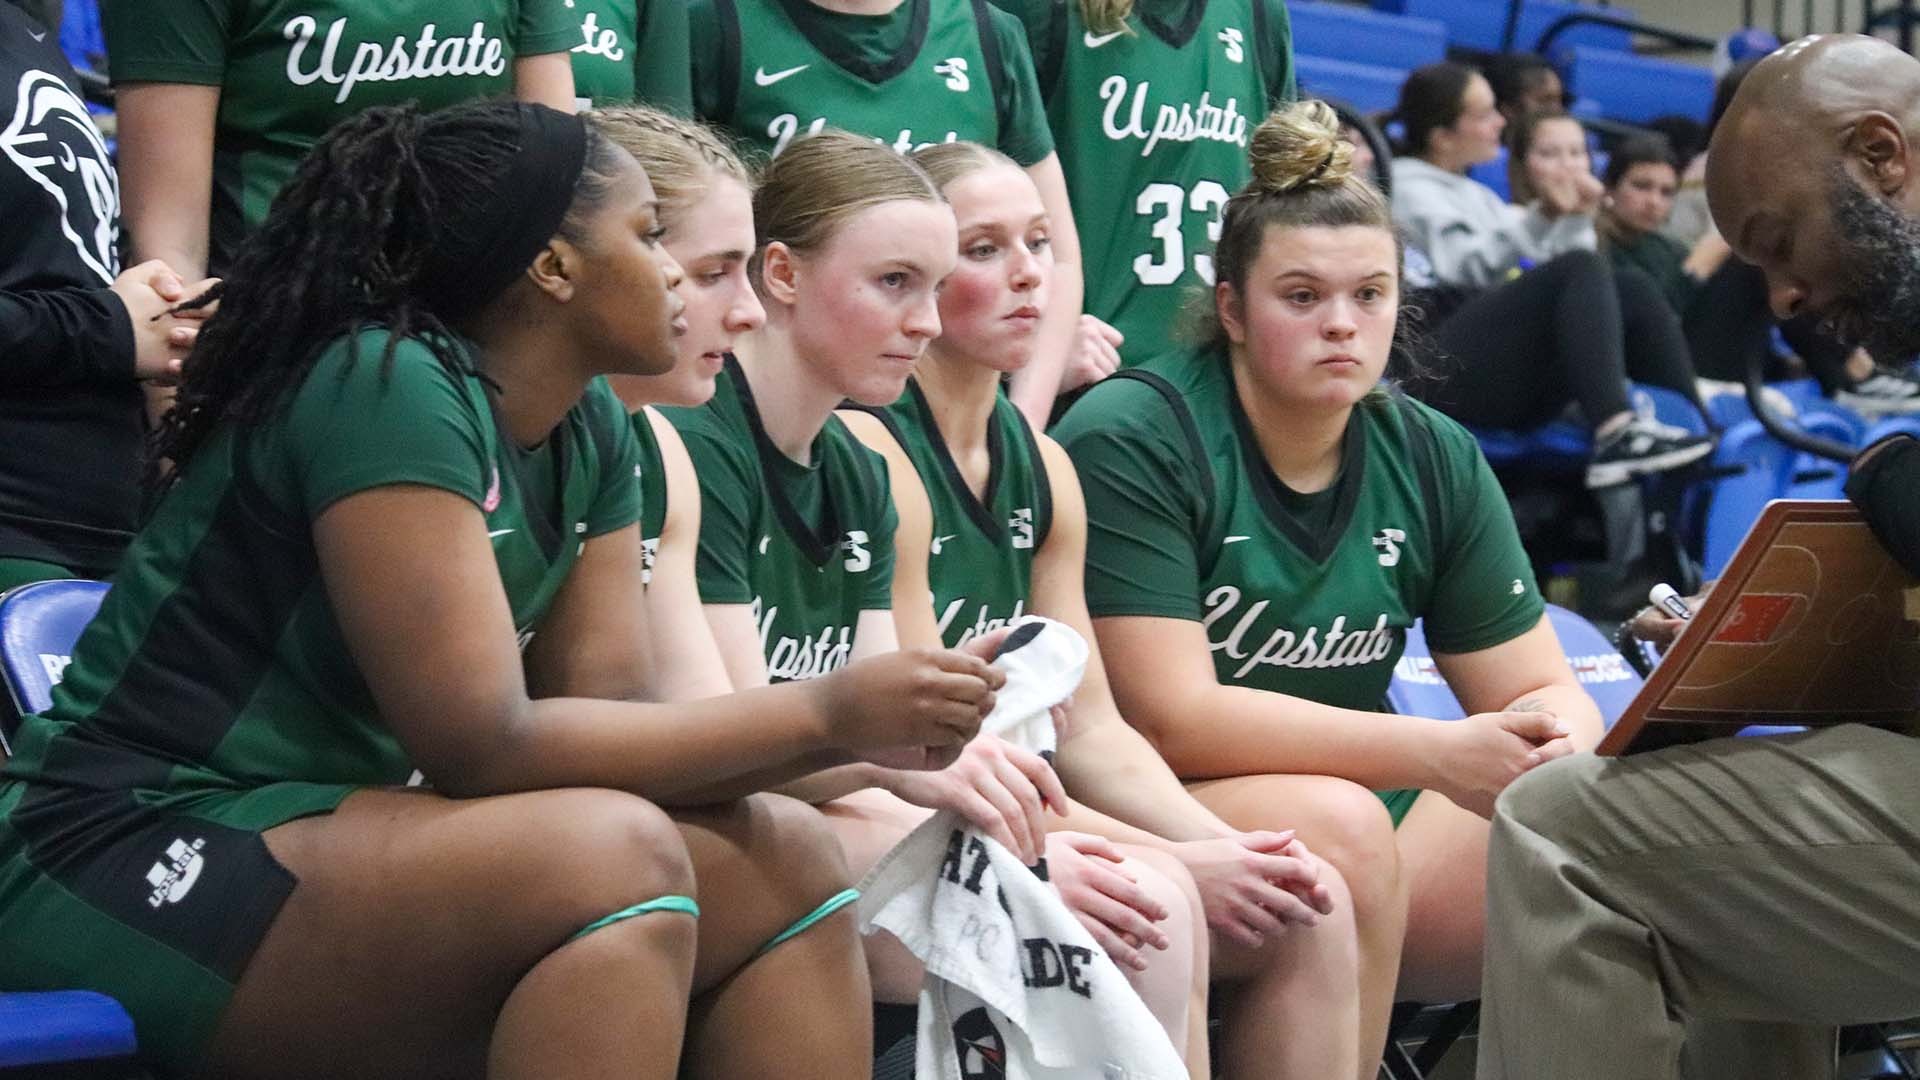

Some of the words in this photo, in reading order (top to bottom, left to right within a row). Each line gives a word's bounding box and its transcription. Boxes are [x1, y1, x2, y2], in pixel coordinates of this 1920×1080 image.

[283, 15, 506, 104] Upstate
[1099, 75, 1247, 157] Upstate
[1133, 180, 1231, 286] 33
[1202, 585, 1394, 678] Upstate
